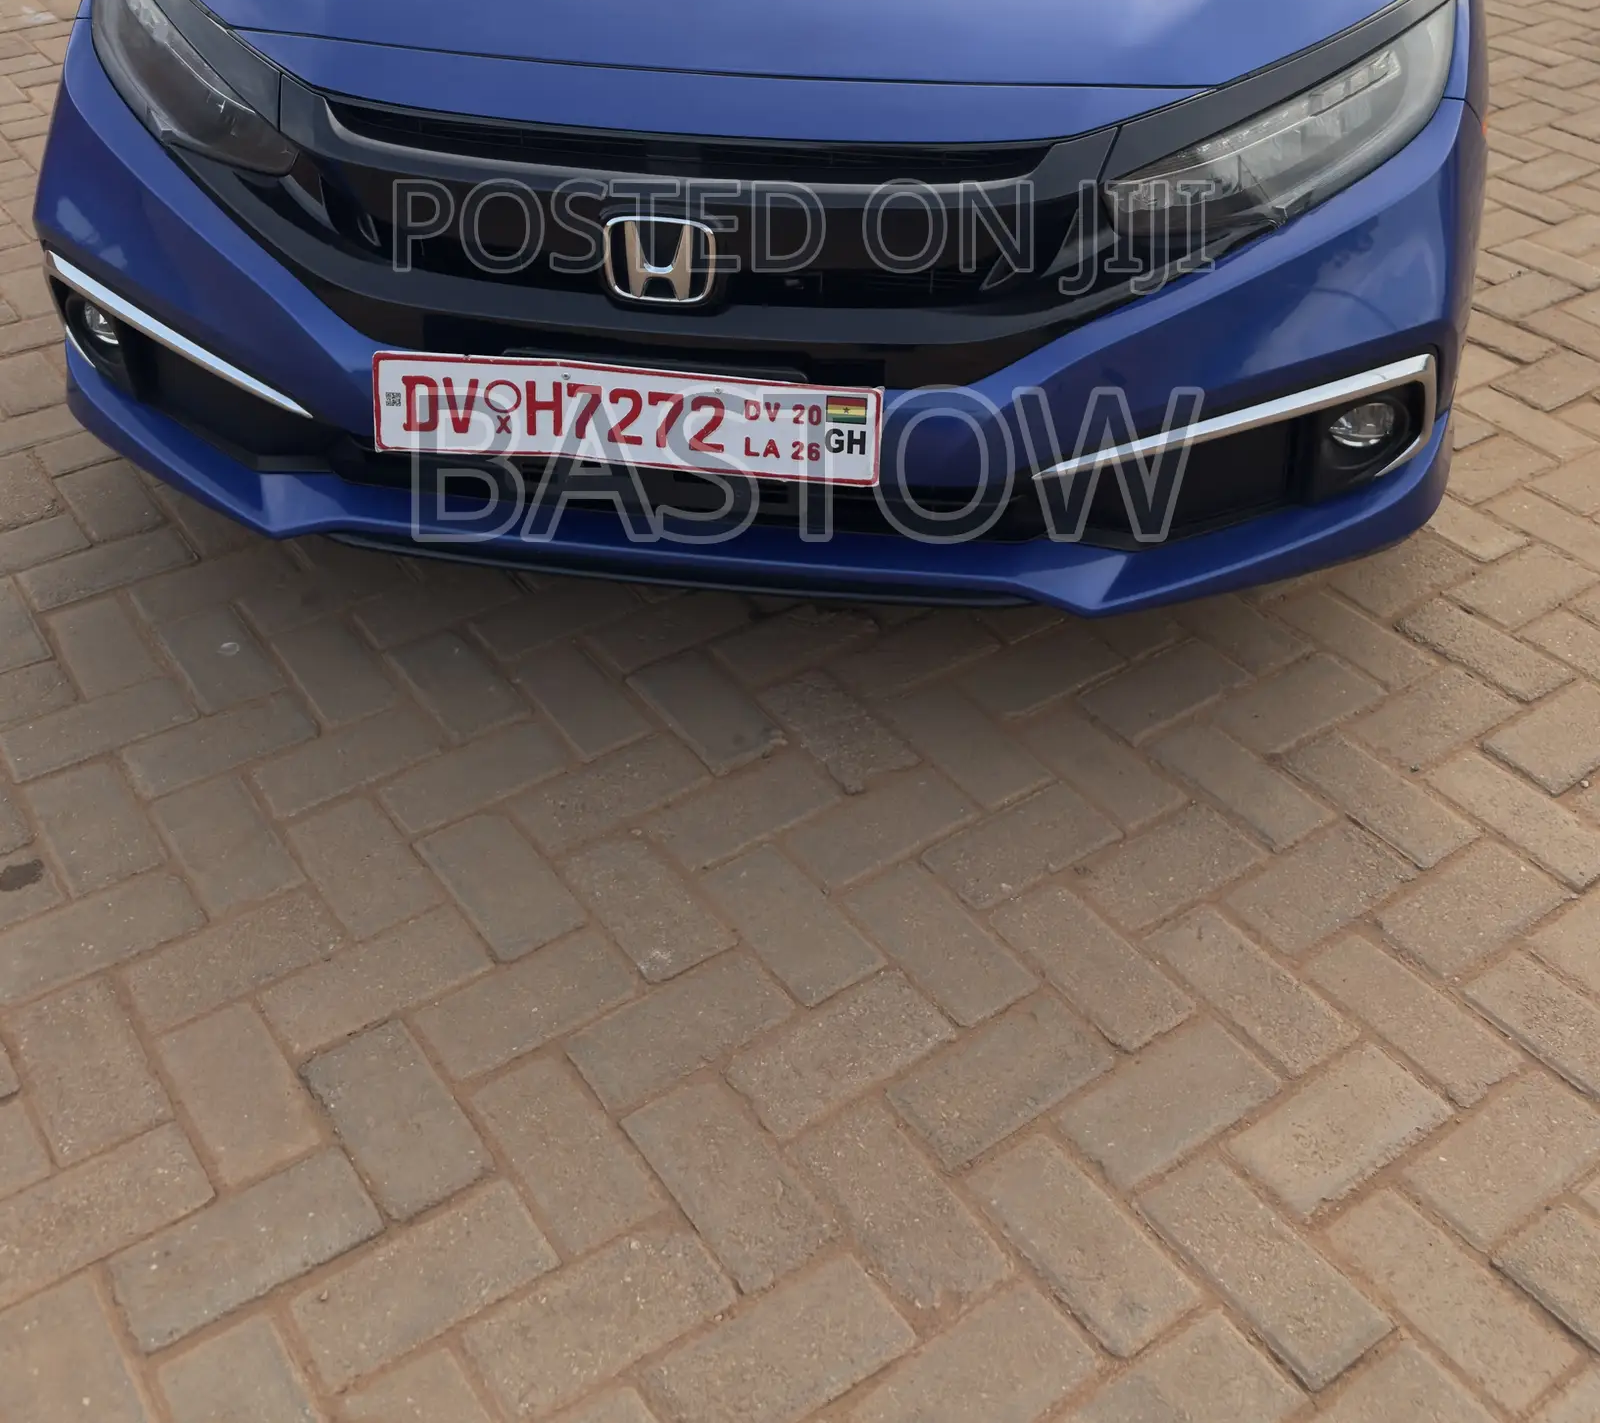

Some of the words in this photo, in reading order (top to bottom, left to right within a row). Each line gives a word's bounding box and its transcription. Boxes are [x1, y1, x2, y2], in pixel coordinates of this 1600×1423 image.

[744, 399, 781, 422] DV
[792, 404, 822, 426] 20
[744, 436, 780, 459] LA
[791, 441, 821, 462] 26
[825, 428, 867, 455] GH
